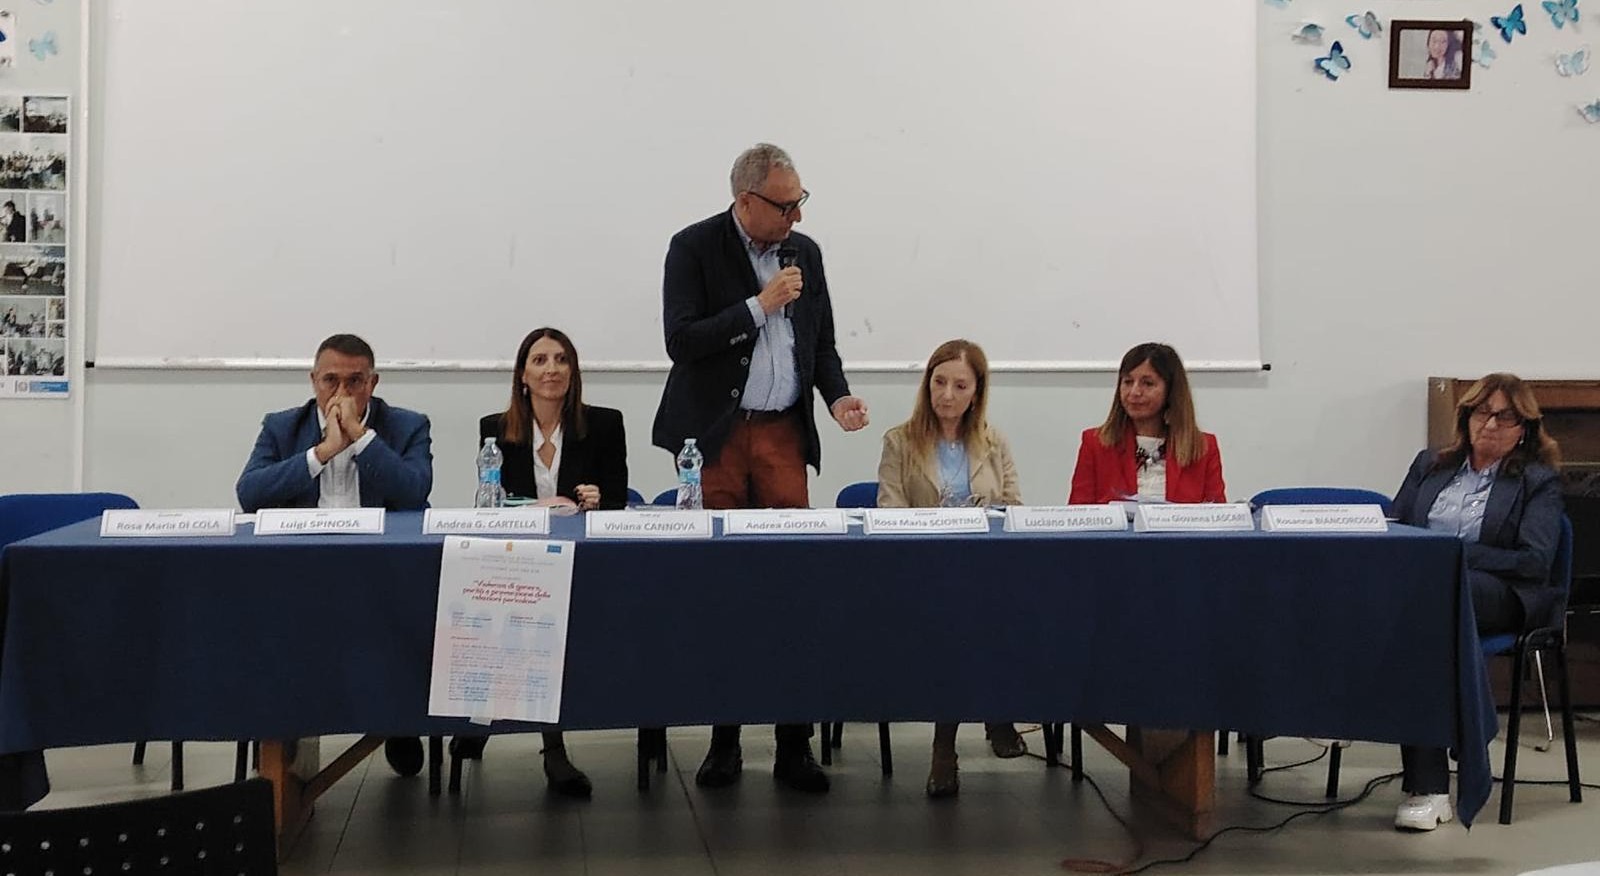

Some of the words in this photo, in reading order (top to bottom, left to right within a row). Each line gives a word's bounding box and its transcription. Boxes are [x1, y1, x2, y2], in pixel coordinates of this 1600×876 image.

[929, 517, 982, 526] SCIORTINO
[1024, 518, 1065, 526] Luciano
[1067, 517, 1113, 526] MARINO
[1171, 514, 1210, 523] Giovanna
[116, 522, 142, 530] Rosa
[145, 522, 176, 530] Maria
[178, 521, 190, 529] DI
[192, 520, 220, 529] COLA
[280, 521, 307, 530] Luigi
[309, 519, 360, 528] SPINOSA
[436, 520, 472, 529] Andrea
[475, 520, 486, 529] G.
[488, 520, 537, 529] CARTELLA
[604, 522, 641, 531] Viviana
[643, 522, 696, 531] CANNOVA
[783, 521, 827, 529] GIOSTRA
